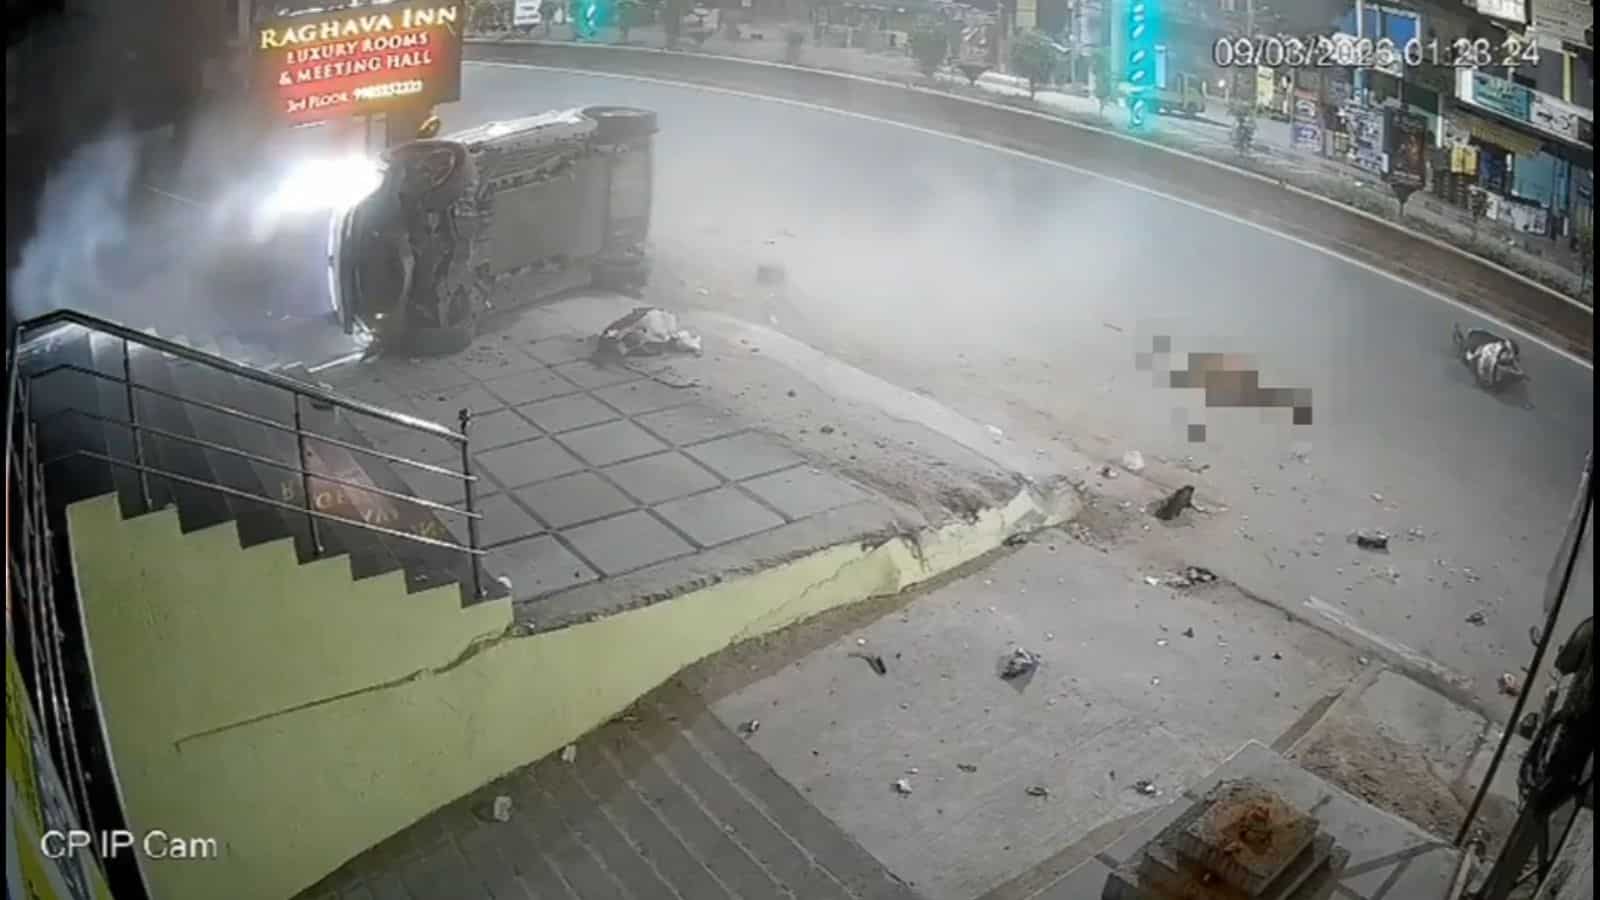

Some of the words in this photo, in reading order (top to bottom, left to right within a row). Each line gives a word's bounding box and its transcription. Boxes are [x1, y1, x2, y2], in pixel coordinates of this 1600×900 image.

[260, 14, 393, 49] RAGHAVA
[401, 6, 457, 29] INN
[287, 41, 360, 65] LUXURY
[361, 31, 429, 52] ROOMS
[278, 69, 293, 86] &
[296, 57, 382, 83] MEETING
[387, 50, 433, 68] HALL
